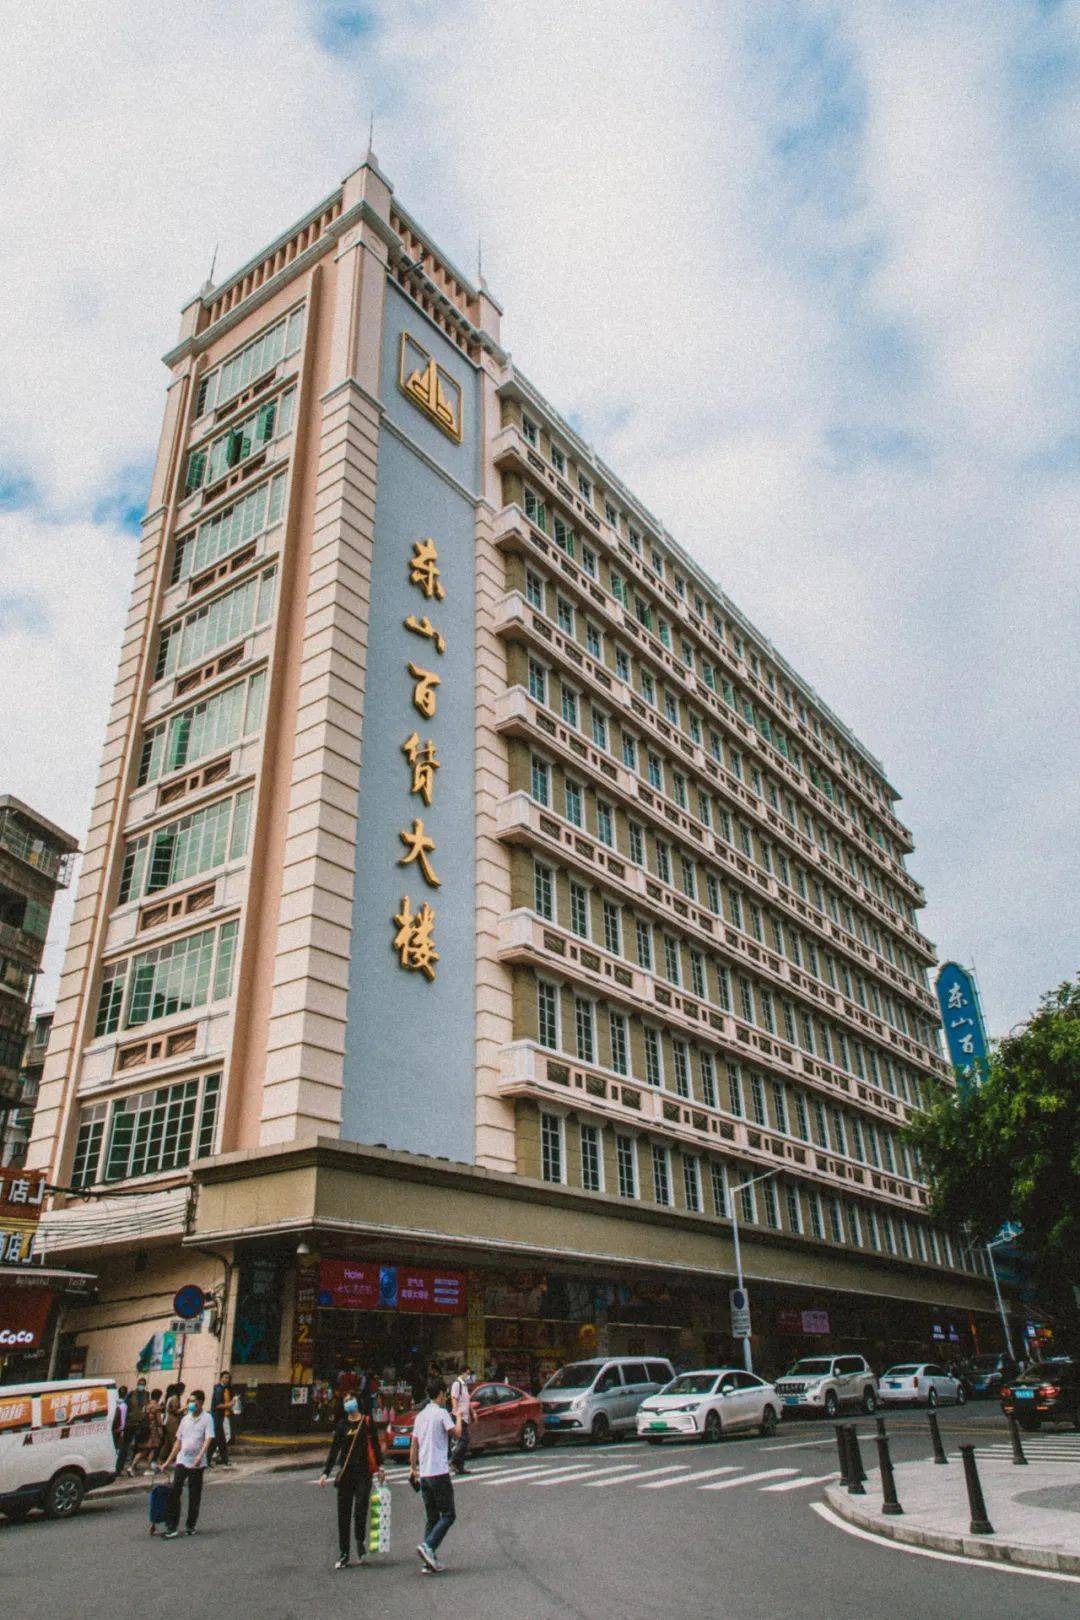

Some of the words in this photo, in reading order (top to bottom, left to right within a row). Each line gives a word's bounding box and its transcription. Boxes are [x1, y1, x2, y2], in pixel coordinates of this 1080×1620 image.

[392, 537, 447, 982] 东山百货大楼
